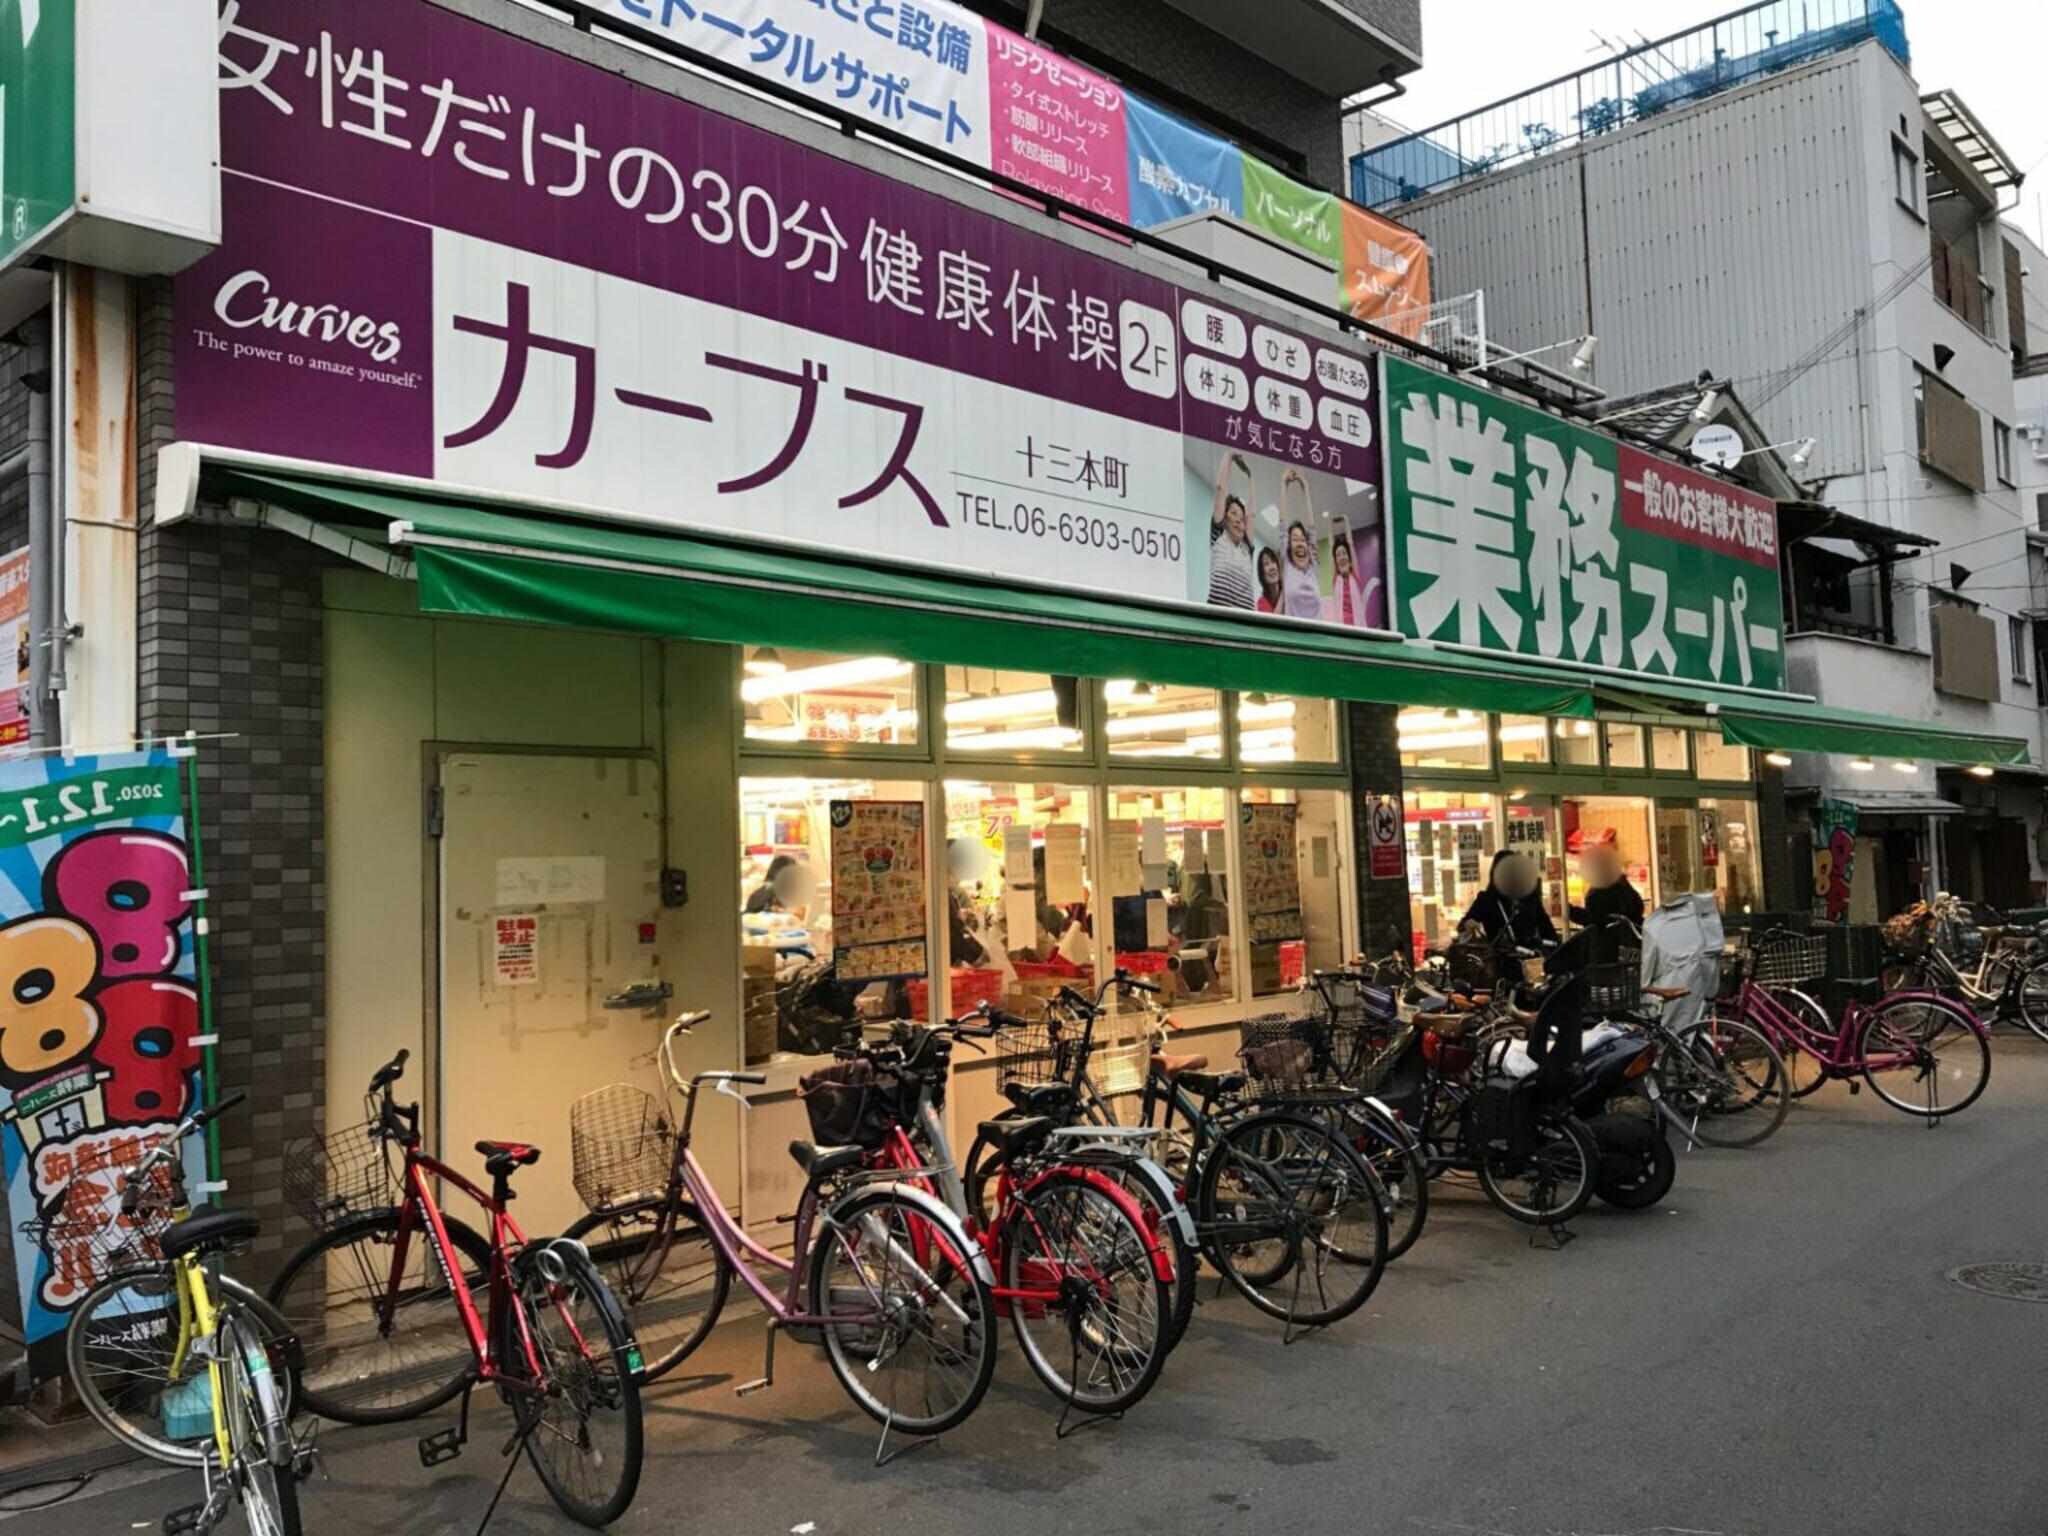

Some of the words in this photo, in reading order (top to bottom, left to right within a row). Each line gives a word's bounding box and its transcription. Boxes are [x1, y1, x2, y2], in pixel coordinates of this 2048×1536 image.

[788, 0, 972, 75] と設備
[995, 34, 1121, 112] リラクゼーション
[219, 0, 1118, 372] 女性だけの30分健康体操
[213, 269, 401, 364] Curves
[1206, 314, 1225, 346] 腰
[193, 329, 228, 351] The
[233, 341, 283, 364] power
[287, 354, 304, 367] to
[308, 357, 355, 376] amaze
[1127, 320, 1169, 378] 2F
[1265, 338, 1298, 369] ひざ
[1317, 359, 1369, 391] お腹たるみ
[443, 280, 951, 528] カーブス
[1198, 365, 1237, 400] 体力
[1266, 386, 1303, 419] 体重
[1224, 414, 1343, 471] が気になる方
[1330, 408, 1362, 438] 血圧
[1015, 435, 1130, 498] 十三本町
[956, 491, 1182, 562] TEL.06-6303-0510
[1400, 392, 1779, 688] 業務スーパー
[1623, 467, 1776, 556] 一般のお客様大歓迎
